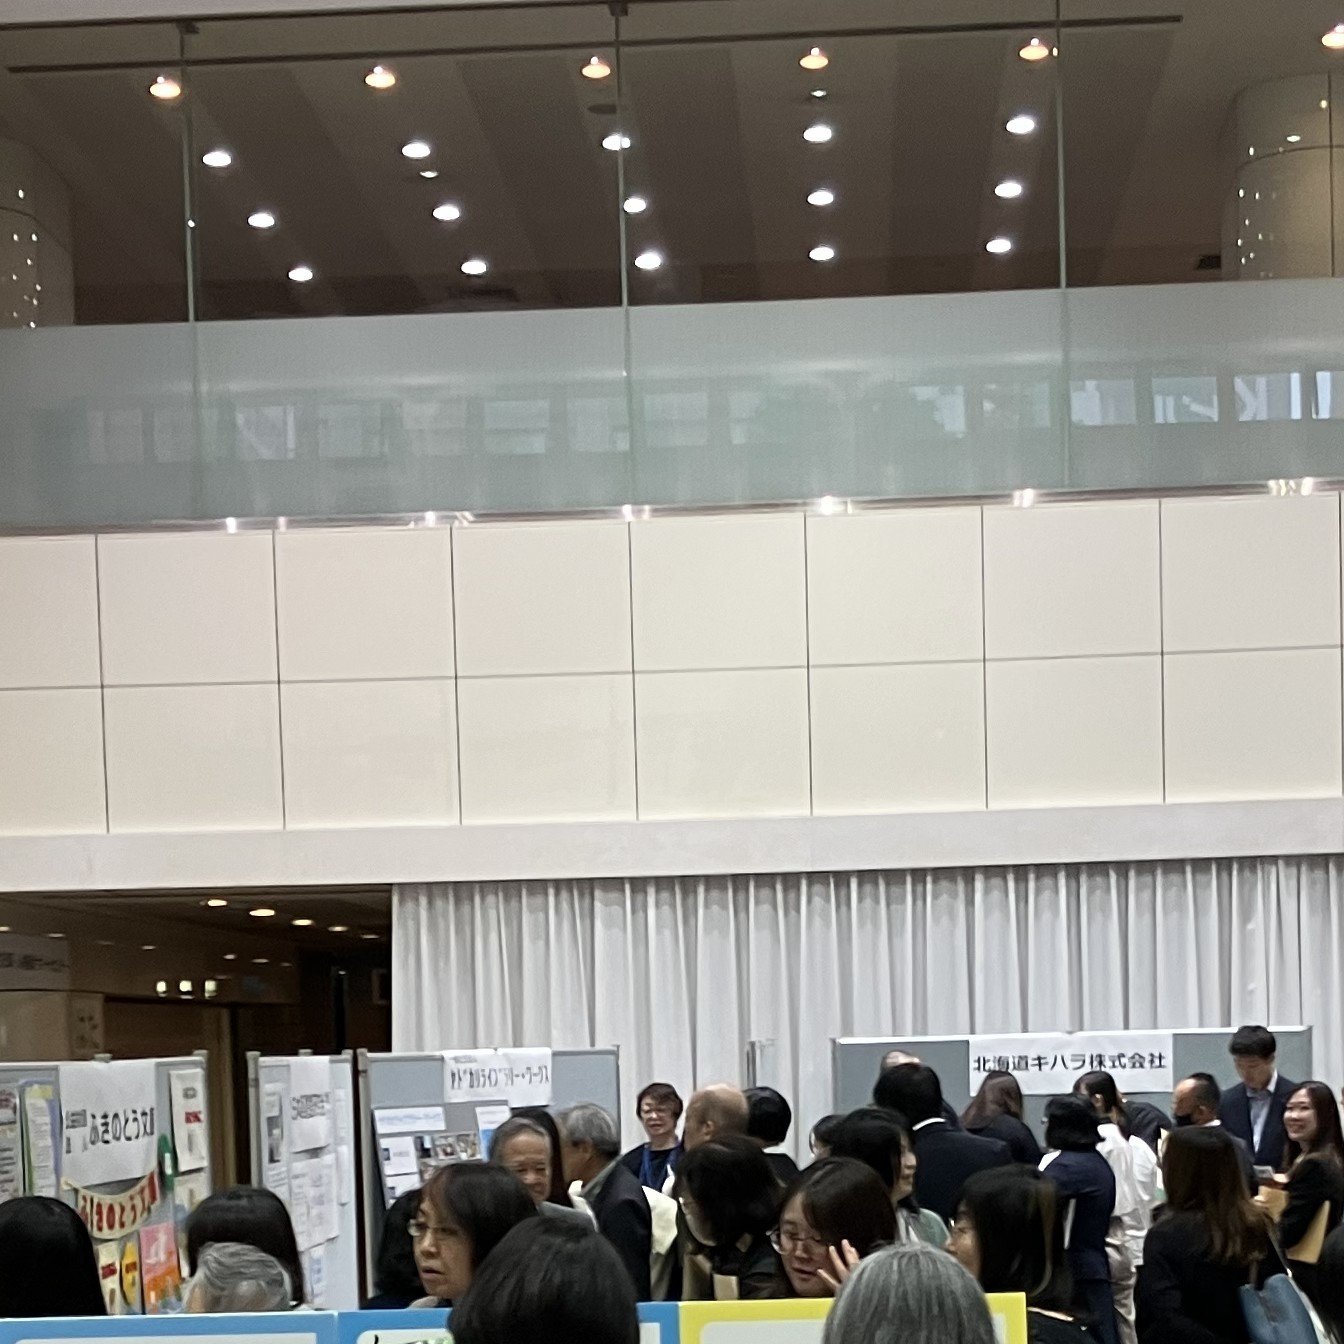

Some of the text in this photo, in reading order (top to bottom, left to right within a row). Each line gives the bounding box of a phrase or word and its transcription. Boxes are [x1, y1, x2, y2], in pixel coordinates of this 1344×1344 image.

[972, 1052, 1167, 1073] 北海道キハラ株式会社
